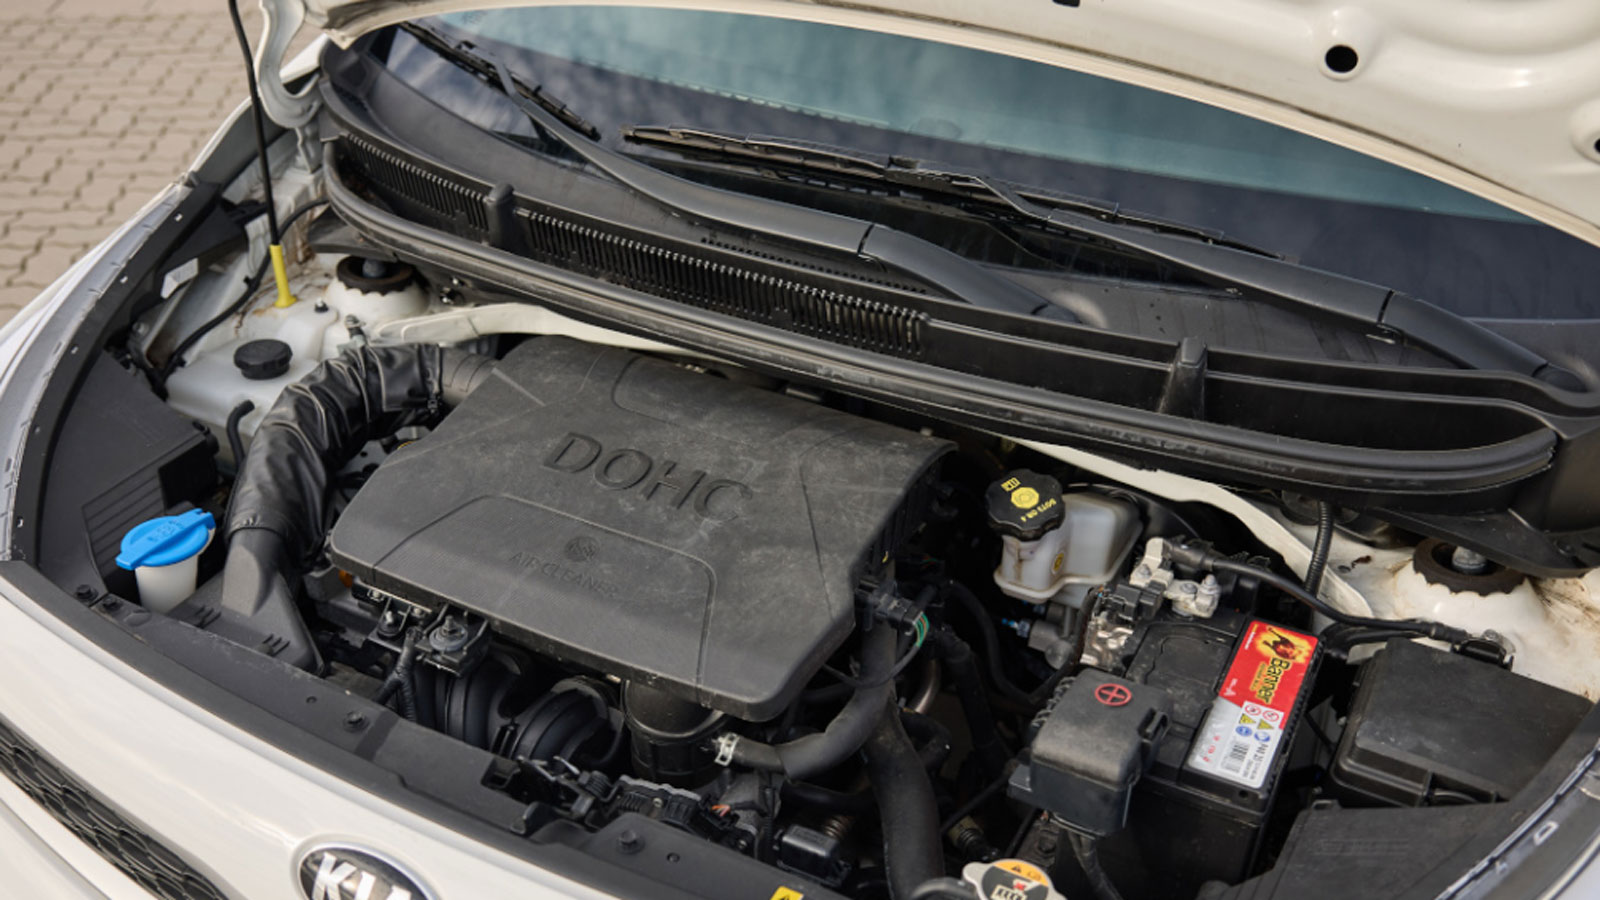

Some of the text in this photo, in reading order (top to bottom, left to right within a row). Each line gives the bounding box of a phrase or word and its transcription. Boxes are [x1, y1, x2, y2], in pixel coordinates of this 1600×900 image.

[543, 431, 753, 523] DOHC
[508, 551, 540, 570] AIR
[1257, 657, 1290, 704] Banner
